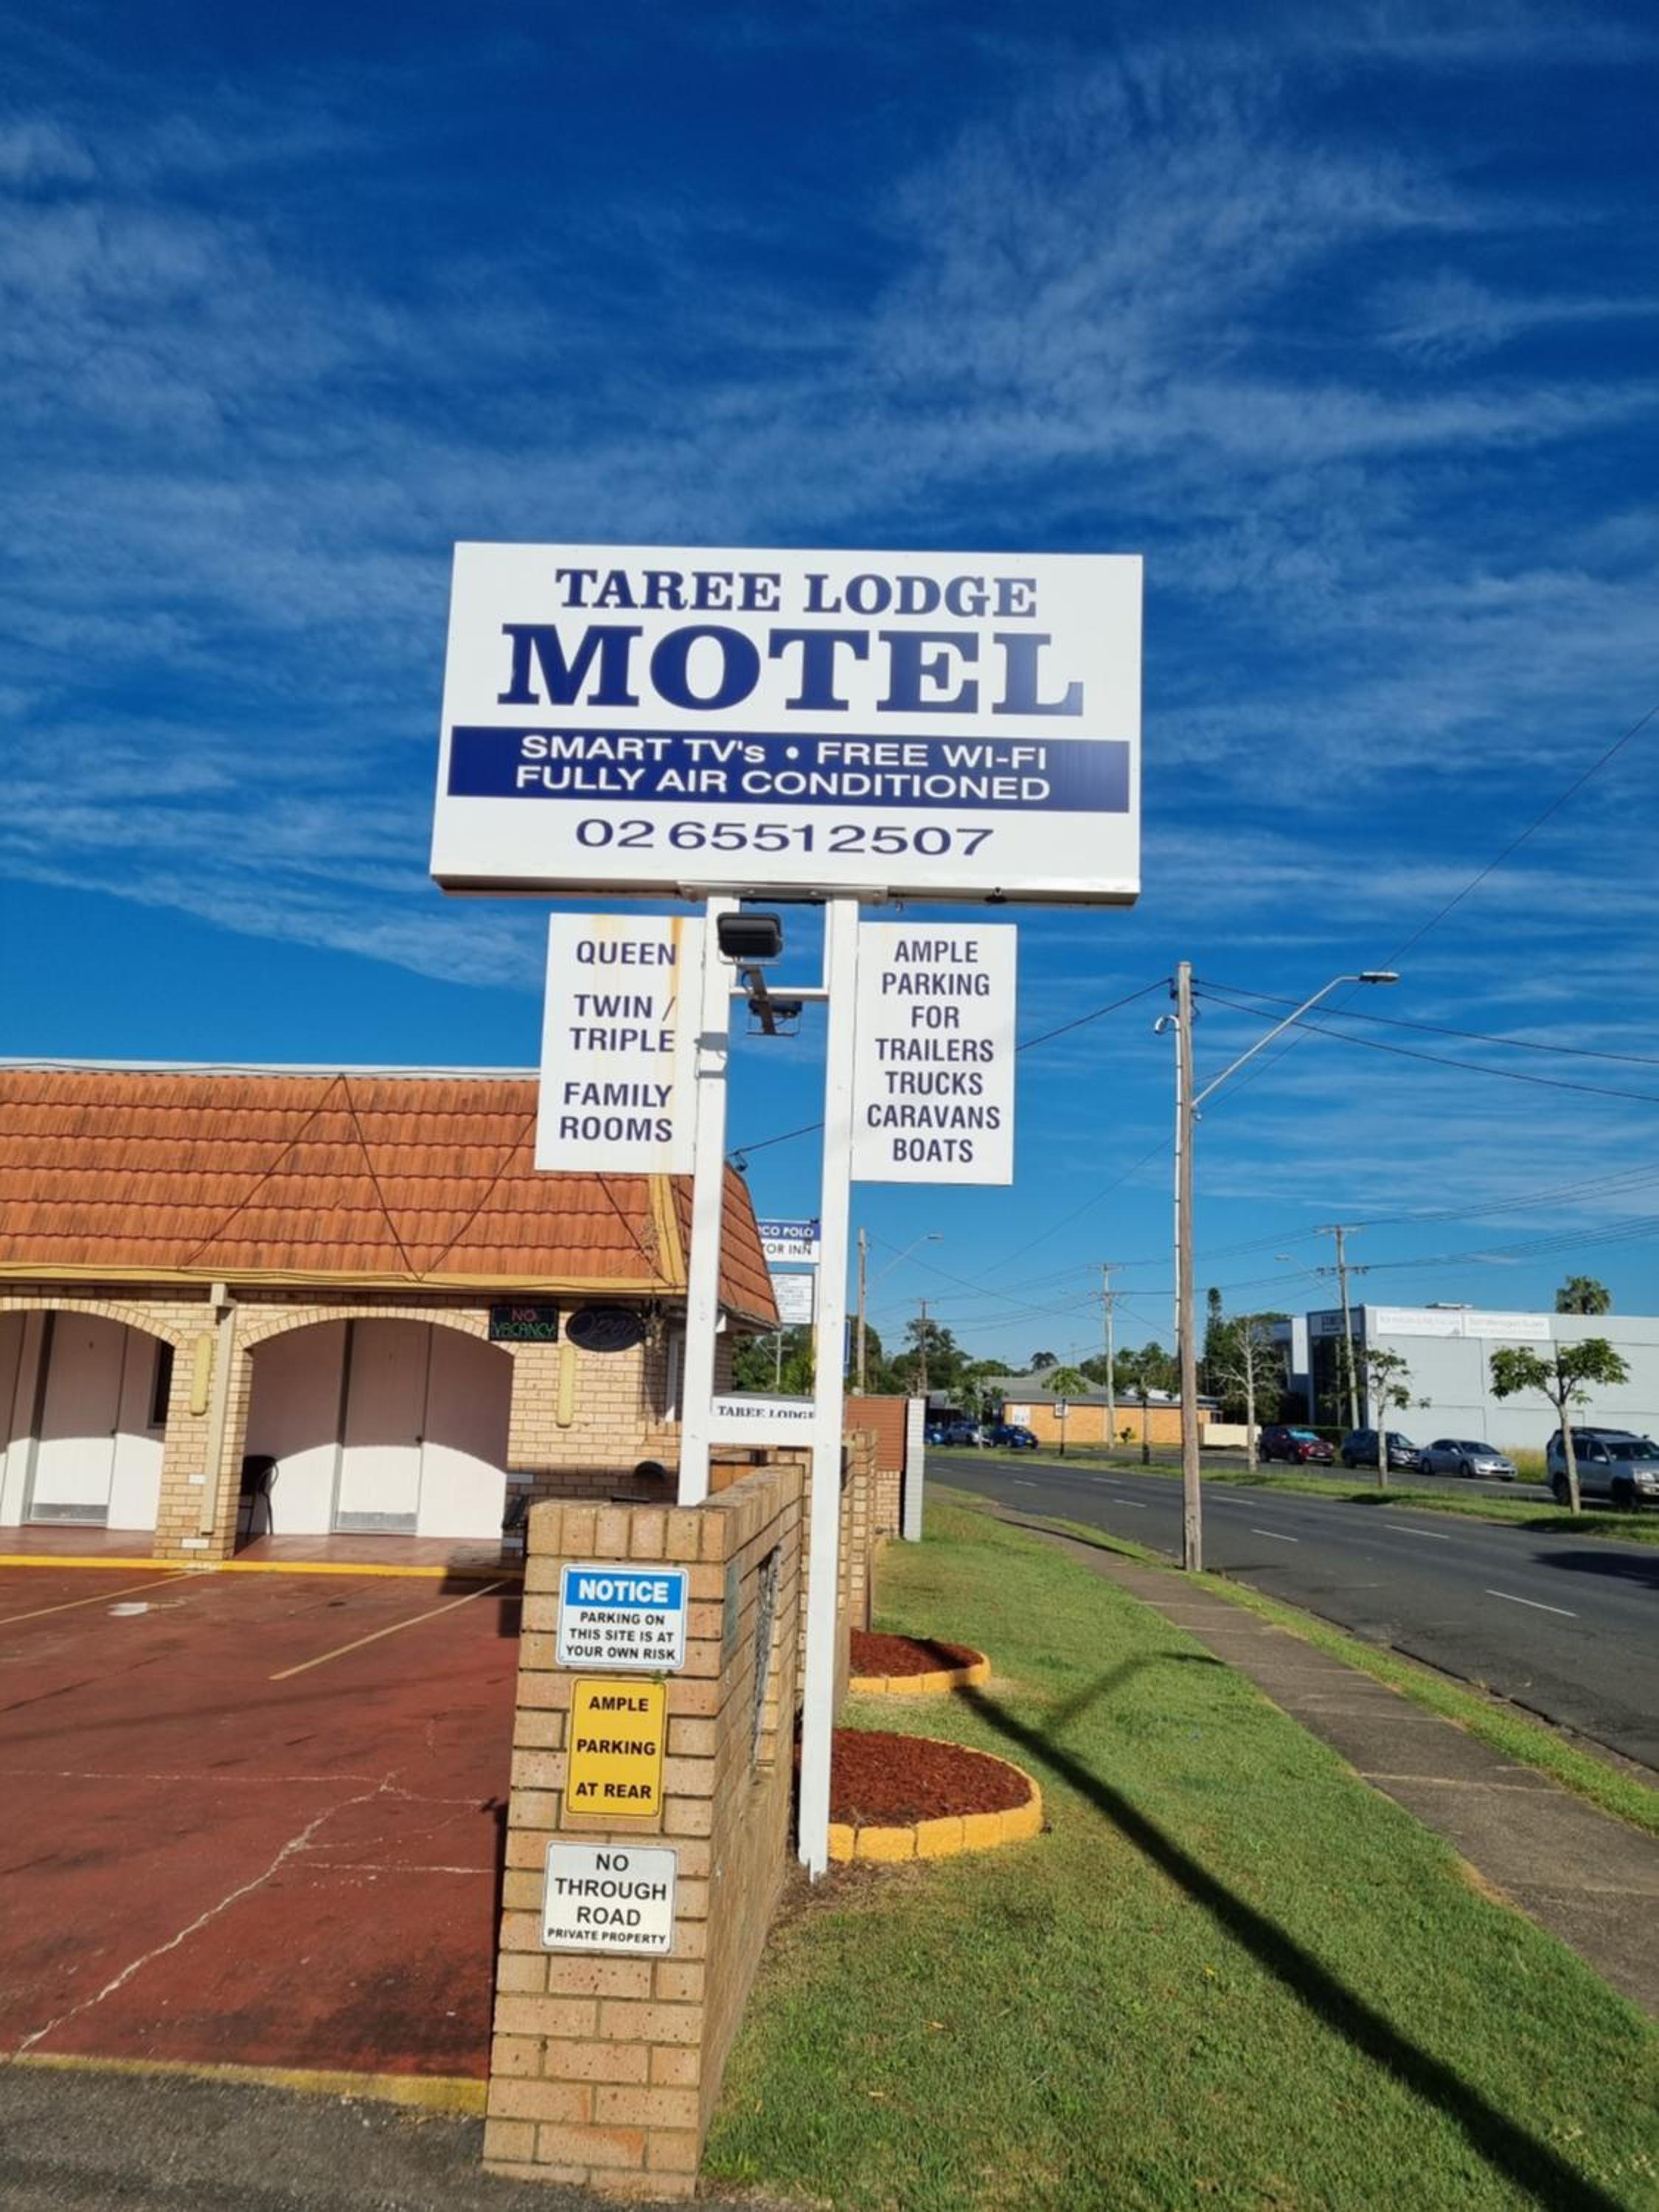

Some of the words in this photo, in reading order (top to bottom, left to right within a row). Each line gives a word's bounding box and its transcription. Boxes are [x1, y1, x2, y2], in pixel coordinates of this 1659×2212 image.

[556, 569, 780, 611] TAREE
[804, 574, 1036, 617] LODGE
[498, 624, 1082, 715] MOTEL
[521, 735, 672, 761] SMART
[684, 739, 765, 763] TV's
[818, 742, 928, 767] FREE
[942, 745, 1046, 770] WI-FI
[517, 765, 644, 790] FULLY
[656, 769, 727, 793] AIR
[742, 771, 1050, 800] CONDITIONED
[577, 819, 654, 848] 02
[577, 941, 677, 966] QUEEN
[894, 941, 978, 963] AMPLE
[883, 973, 989, 996] PARKING
[574, 995, 652, 1018] TWIN
[912, 1006, 959, 1029] FOR
[570, 1028, 675, 1052] TRIPLE
[875, 1038, 993, 1062] TRAILERS
[564, 1082, 672, 1107] FAMILY
[885, 1071, 982, 1096] TRUCKS
[867, 1104, 1000, 1130] CARAVANS
[560, 1116, 672, 1142] ROOMS
[894, 1138, 973, 1163] BOATS
[783, 1227, 814, 1237] POLO
[789, 1244, 812, 1255] INN
[511, 1309, 537, 1321] NO
[493, 1322, 554, 1338] VACANCY
[579, 1579, 669, 1603] NOTICE
[580, 1612, 640, 1624] PARKING
[645, 1615, 664, 1625] ON
[570, 1628, 600, 1640] THIS
[605, 1630, 635, 1641] SITE
[640, 1631, 653, 1642] IS
[657, 1632, 673, 1642] AT
[566, 1646, 602, 1657] YOUR
[608, 1647, 639, 1658] OWN
[644, 1649, 675, 1660] RISK
[589, 1697, 648, 1712] AMPLE
[577, 1739, 655, 1756] PARKING
[576, 1782, 598, 1796] AT
[605, 1784, 651, 1799] REAR
[597, 1854, 629, 1871] NO
[554, 1878, 667, 1900] THROUGH
[577, 1906, 641, 1926] ROAD
[548, 1928, 597, 1941] PRIVATE
[602, 1932, 665, 1944] PROPERTY
